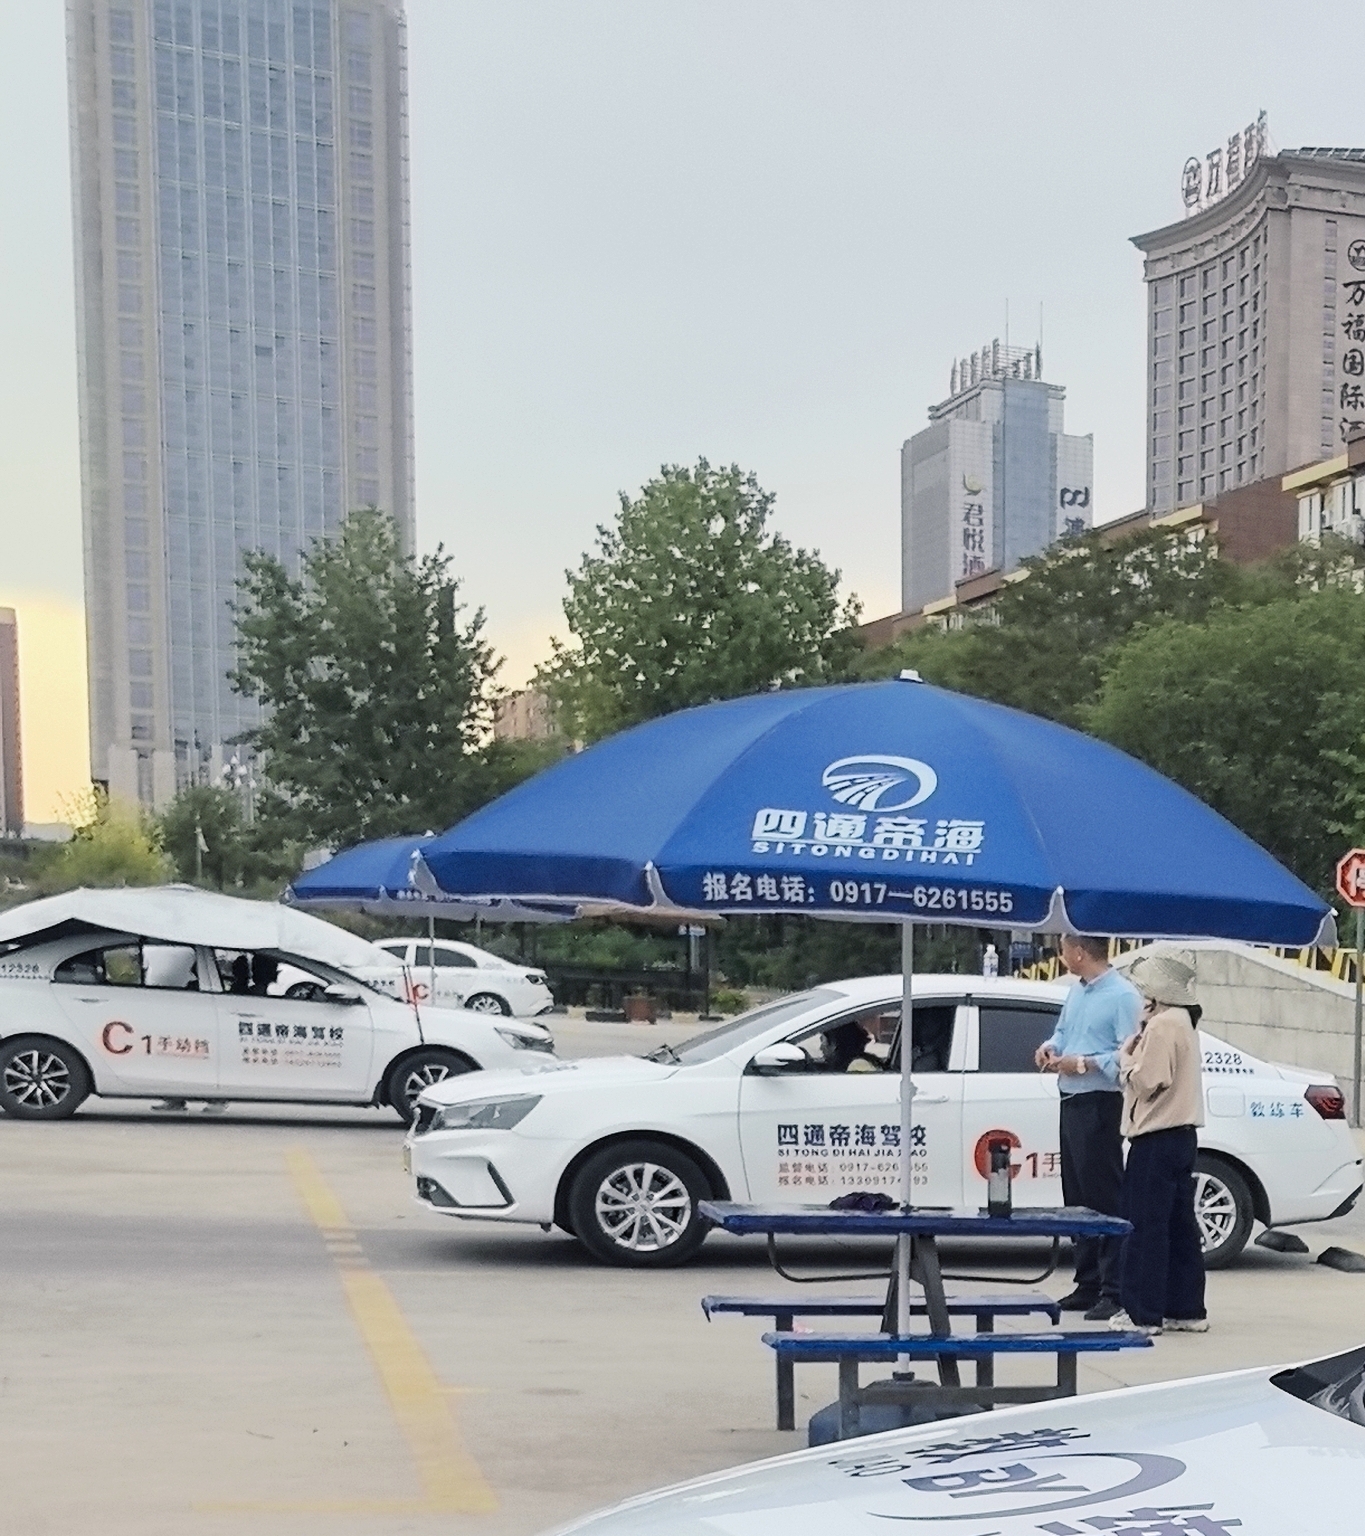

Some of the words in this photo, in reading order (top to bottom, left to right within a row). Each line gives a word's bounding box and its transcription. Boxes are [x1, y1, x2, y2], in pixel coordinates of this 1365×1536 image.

[752, 808, 985, 852] 四通帝海
[751, 841, 976, 866] SITONGDIHAI
[702, 872, 815, 903] 报名电话：
